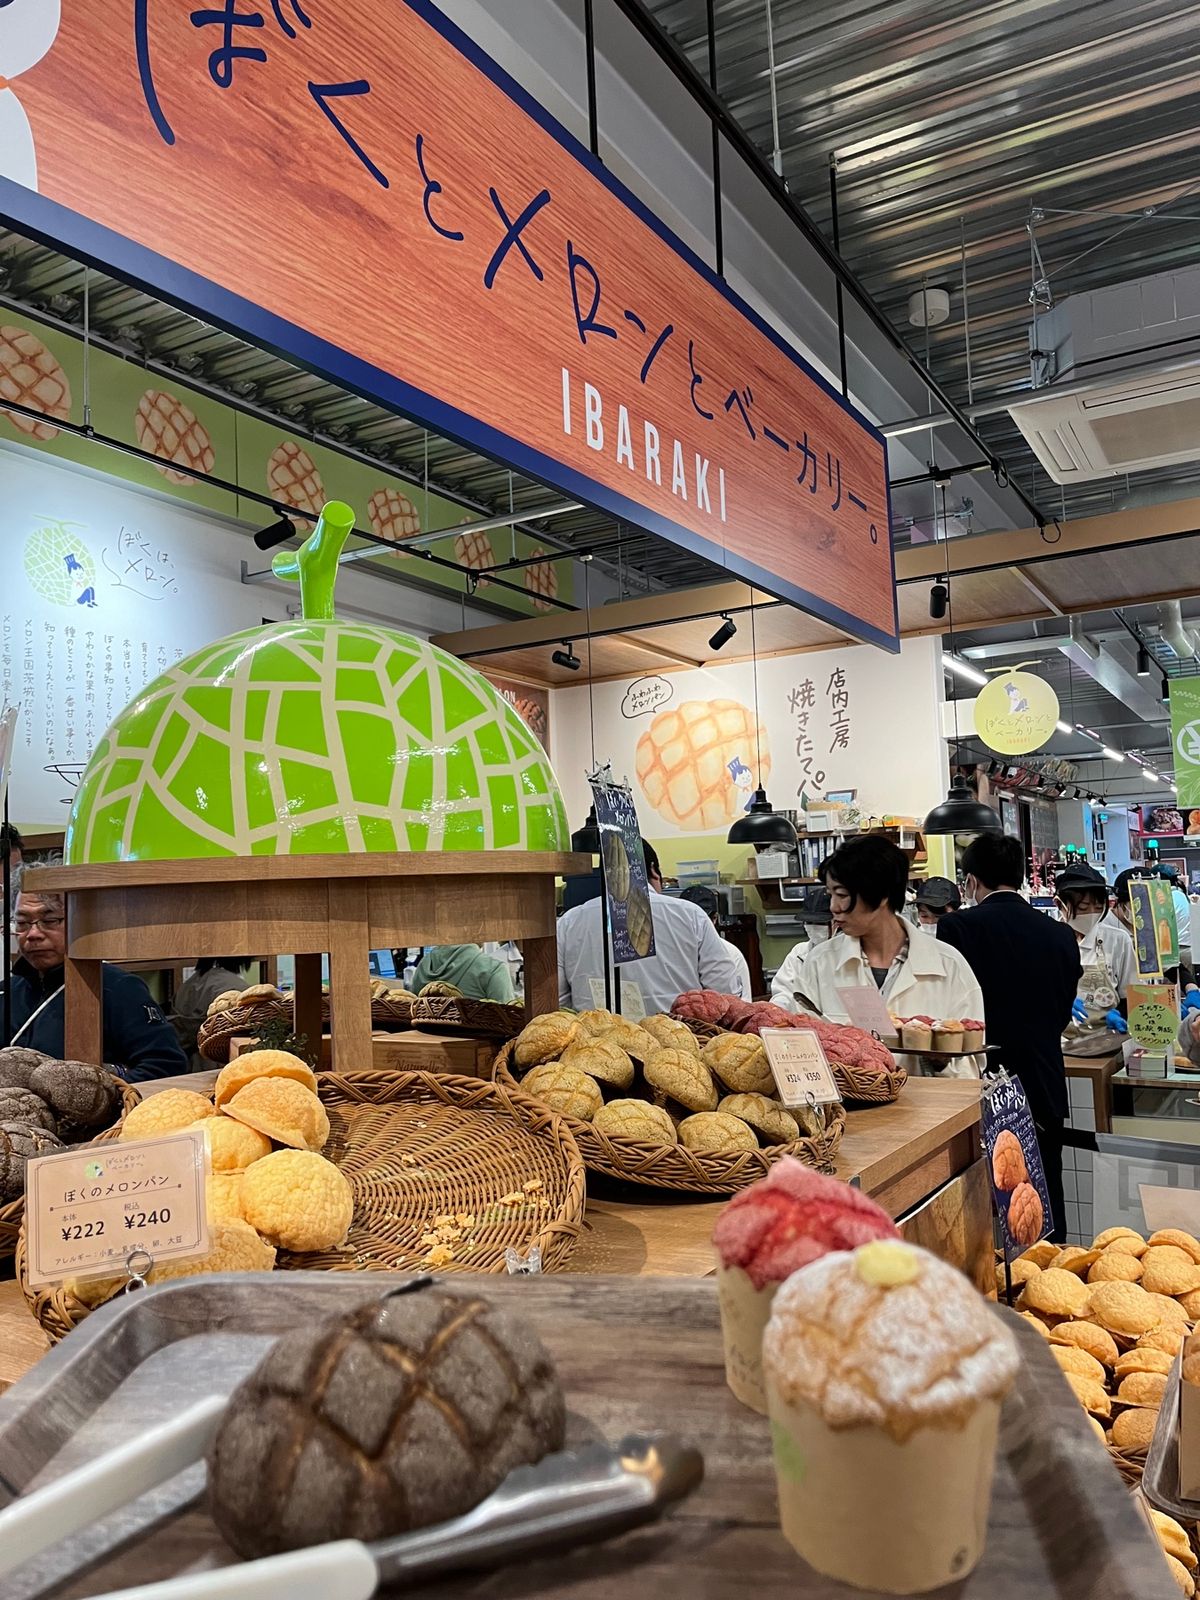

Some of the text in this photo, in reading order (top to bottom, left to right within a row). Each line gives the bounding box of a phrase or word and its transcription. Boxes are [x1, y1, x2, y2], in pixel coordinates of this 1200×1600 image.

[561, 366, 728, 523] IBARAKI
[631, 683, 661, 702] ふわふわ
[632, 692, 665, 712] メロンパン
[825, 666, 851, 754] 店内工房
[786, 677, 826, 798] 焼きたてパ
[64, 1175, 169, 1203] ぼくのメロンパン
[61, 1202, 140, 1221] 本体 税込
[61, 1208, 171, 1241] ¥222 ¥240
